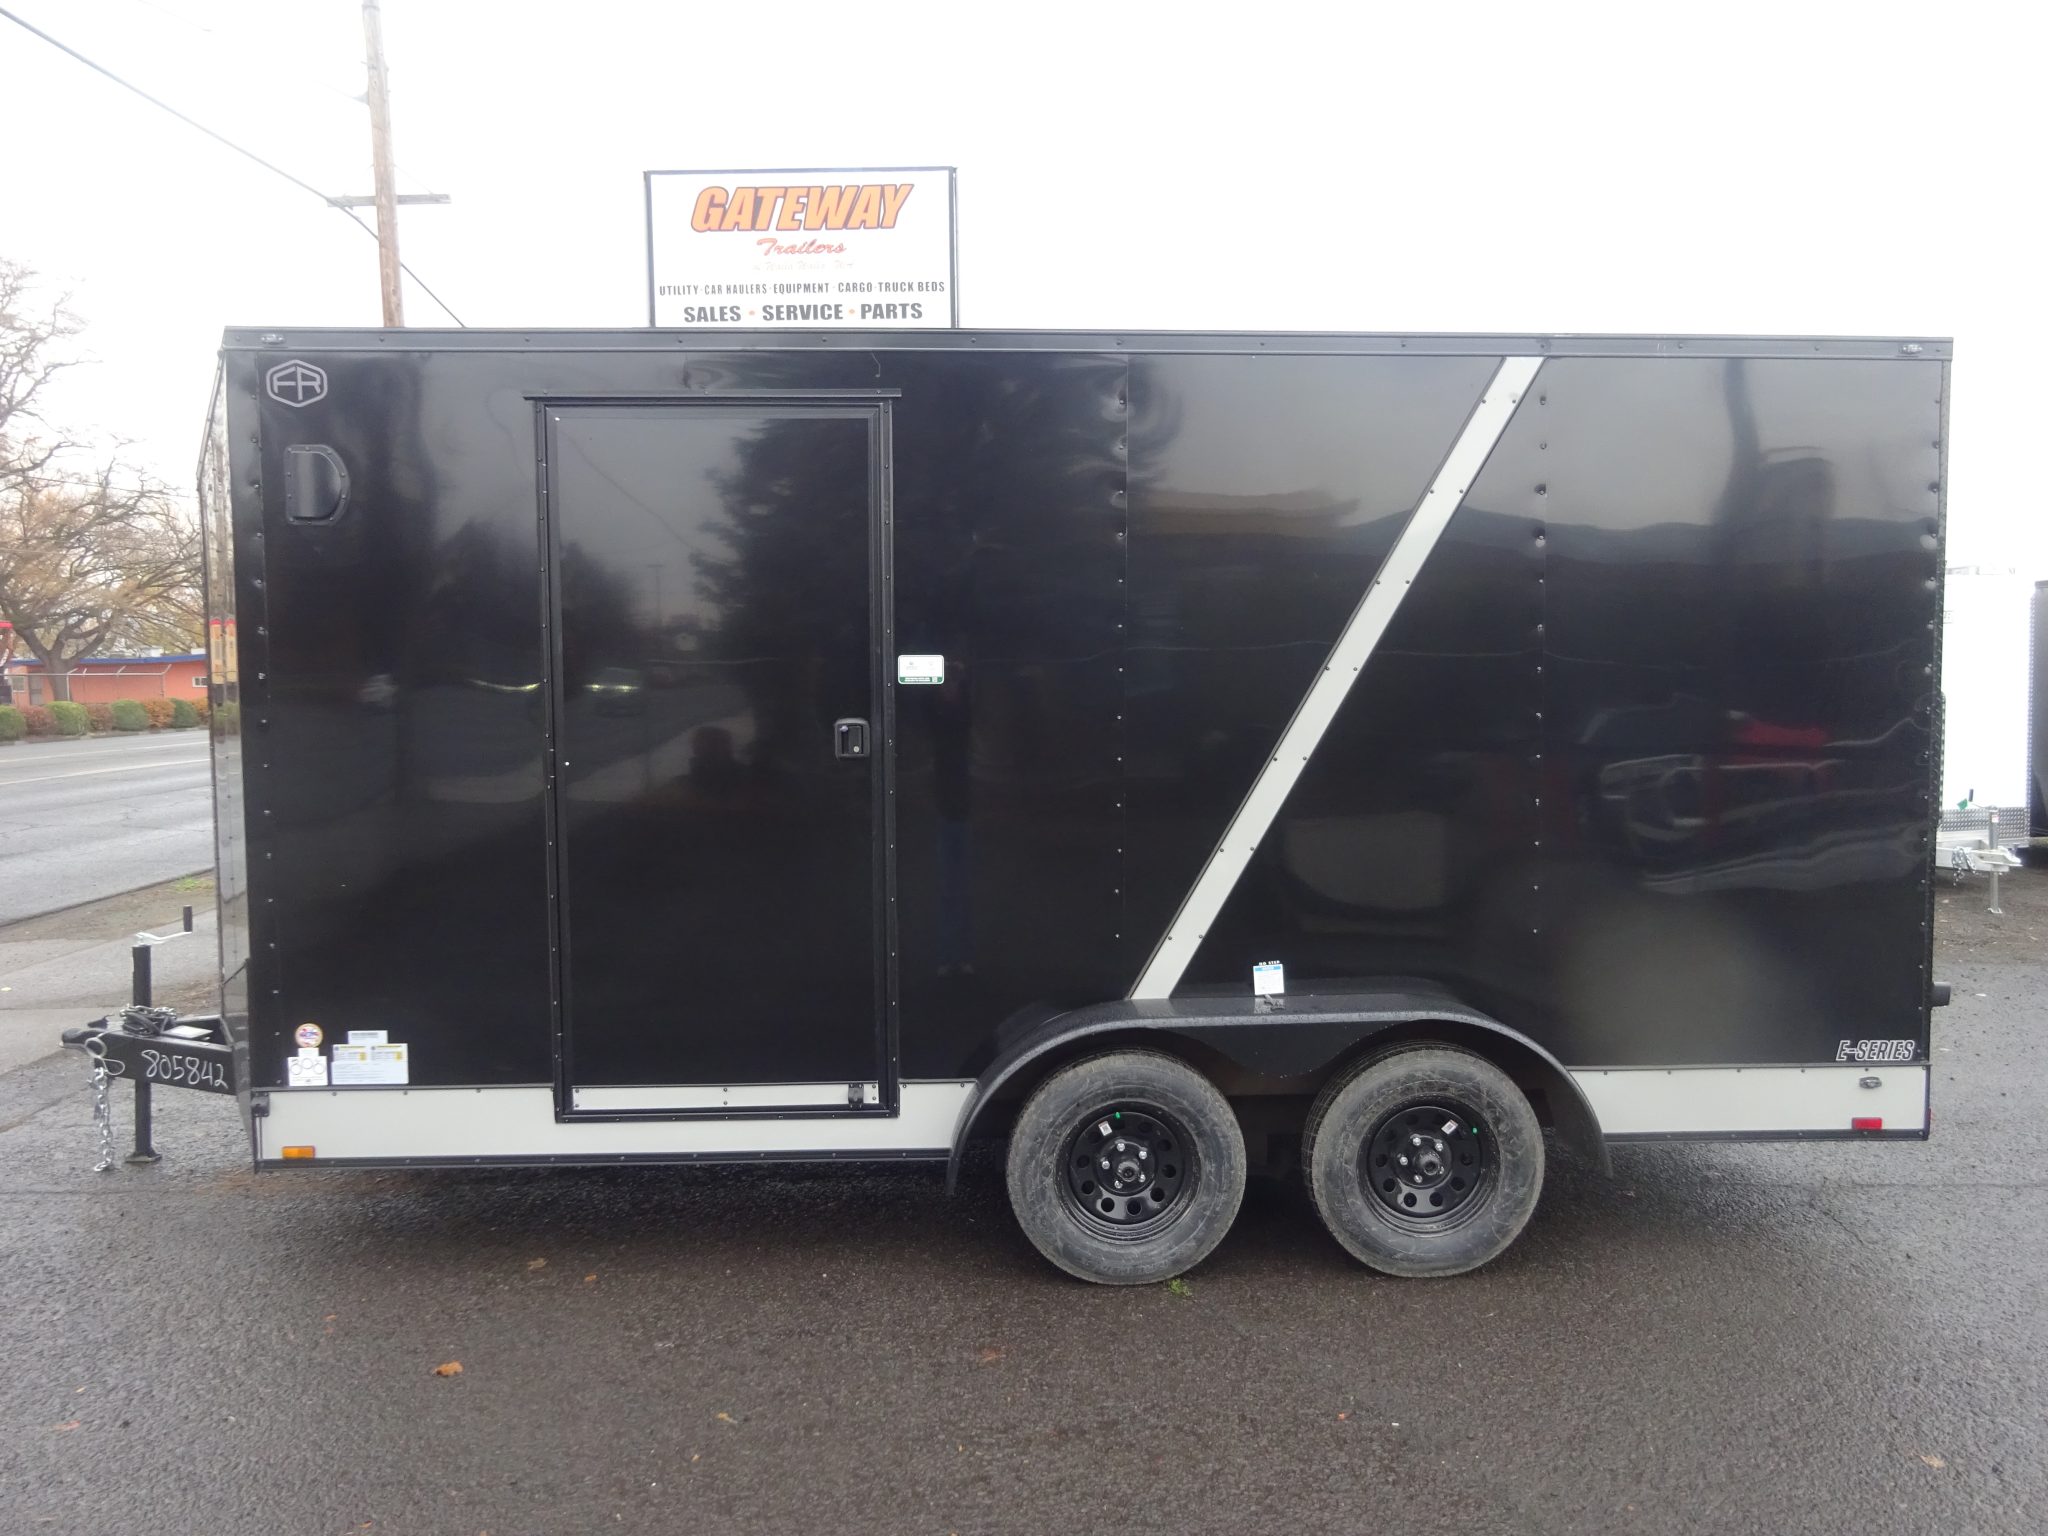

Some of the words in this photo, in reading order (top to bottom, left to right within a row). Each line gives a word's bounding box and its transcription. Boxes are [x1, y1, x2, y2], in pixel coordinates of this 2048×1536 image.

[691, 184, 914, 233] GATEWAY
[659, 285, 699, 296] UTILITY
[704, 284, 723, 295] CAR
[726, 284, 767, 295] HAULERS
[773, 283, 830, 294] EQUIPMENT
[838, 282, 873, 293] CARGO
[878, 282, 914, 293] TRUCK
[917, 281, 945, 292] BEDS
[684, 306, 742, 323] SALES
[762, 304, 843, 321] SERVICE
[860, 303, 923, 320] PARTS
[1836, 1040, 1915, 1062] E-SERIES
[141, 1049, 228, 1089] 805842
